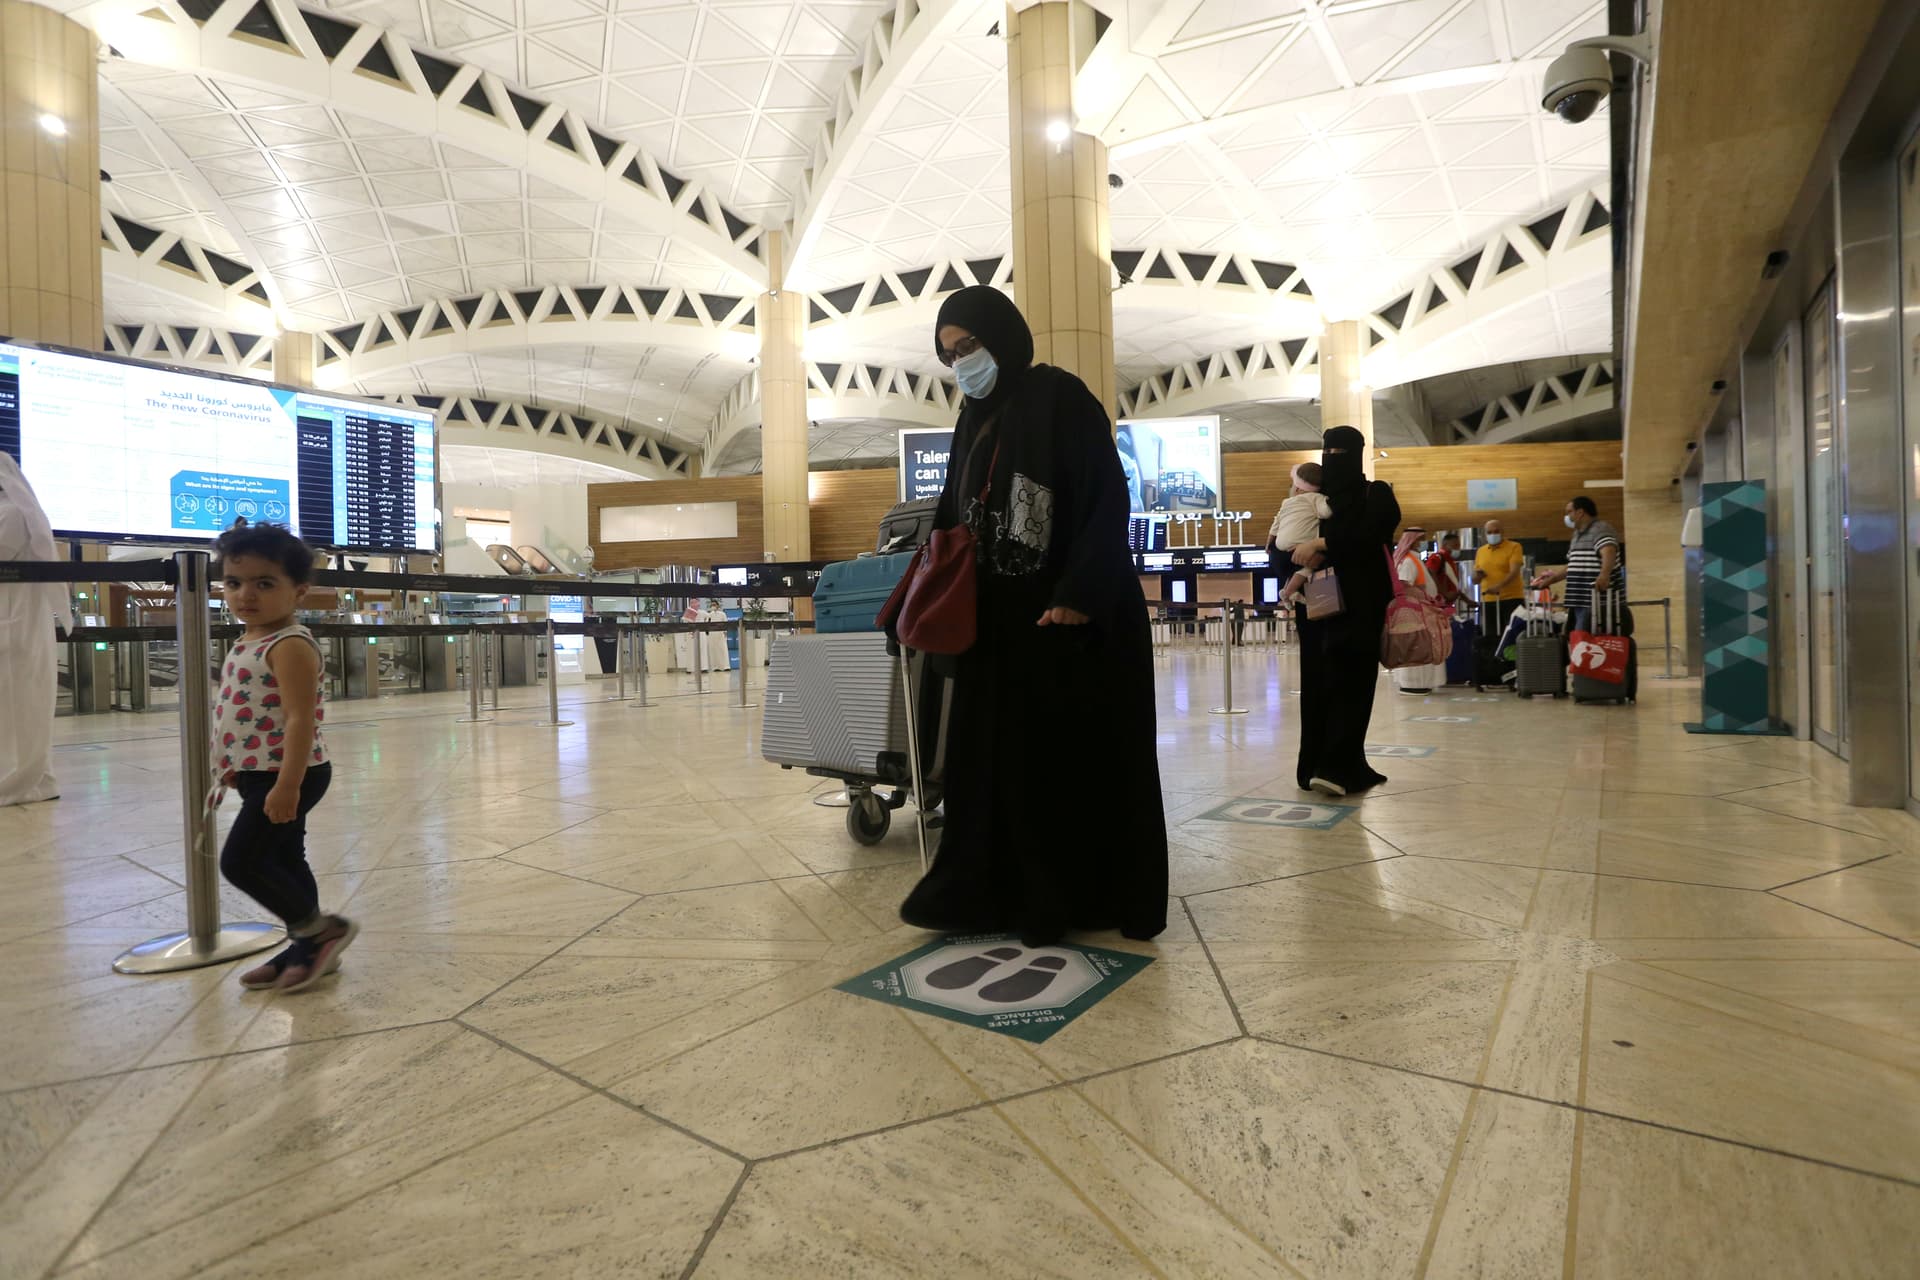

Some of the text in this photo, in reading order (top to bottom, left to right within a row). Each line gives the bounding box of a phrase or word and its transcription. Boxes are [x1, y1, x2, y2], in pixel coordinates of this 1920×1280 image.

[160, 389, 272, 412] فايروس كورونا الجديد
[146, 398, 271, 423] The new Coronavirus
[914, 450, 951, 464] Talen
[915, 468, 940, 480] can
[184, 481, 202, 489] What
[1213, 507, 1252, 527] مرحبا
[550, 595, 582, 603] COVID-19
[992, 1009, 1053, 1021] DISTANCE
[1034, 1014, 1066, 1024] KEEP
[987, 1019, 1019, 1028] SAFE
